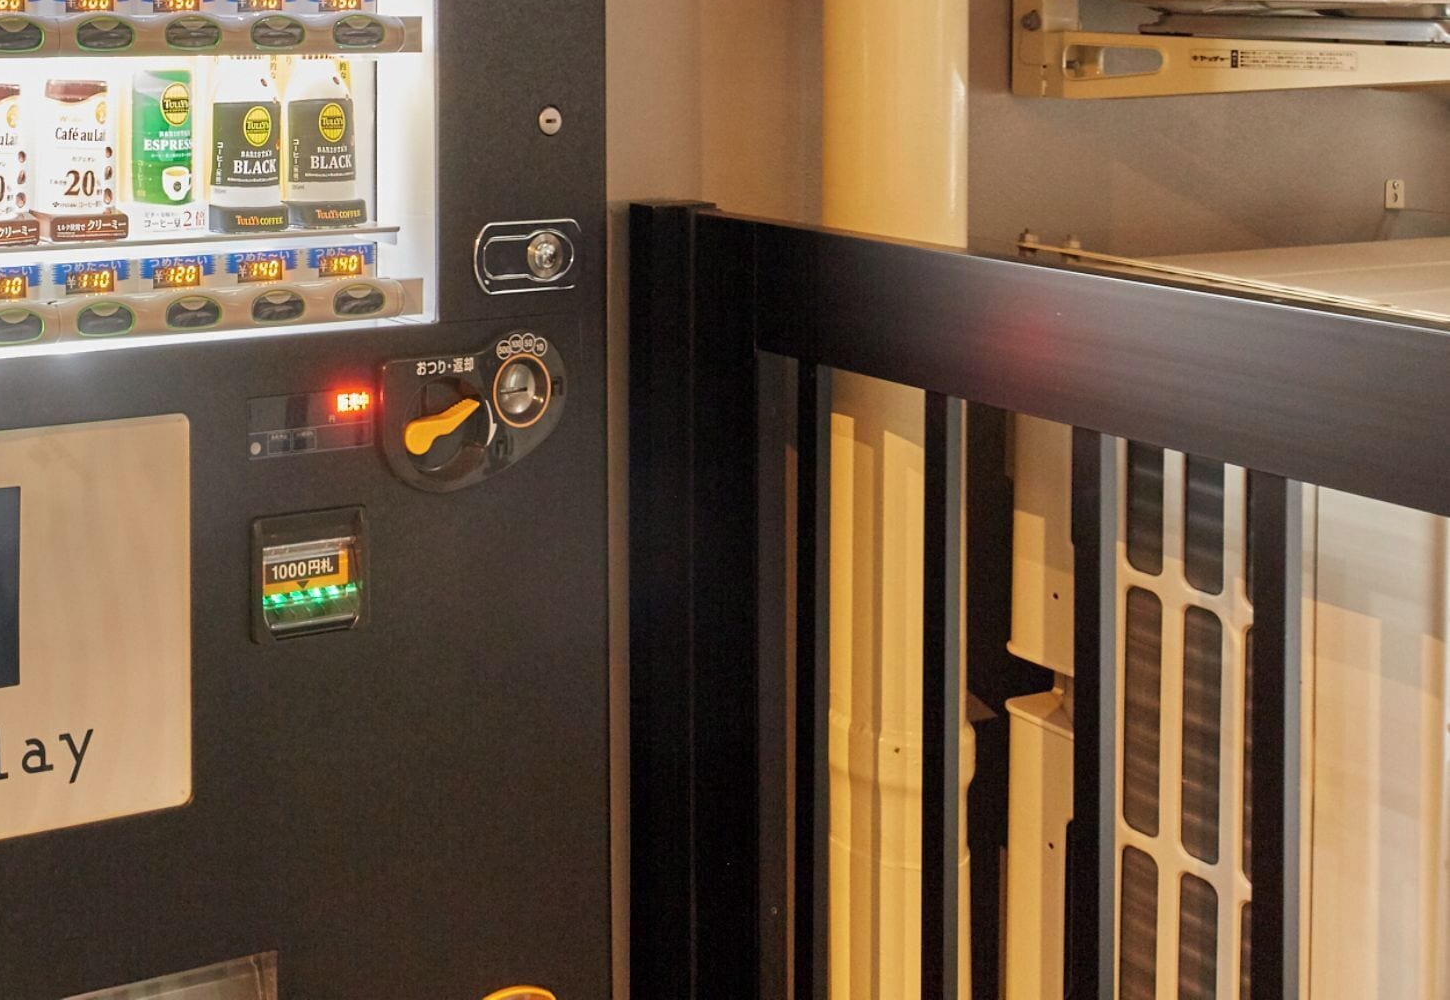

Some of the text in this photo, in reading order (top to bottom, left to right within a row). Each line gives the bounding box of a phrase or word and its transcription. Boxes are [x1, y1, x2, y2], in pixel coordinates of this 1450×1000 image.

[55, 127, 79, 141] Café
[80, 131, 93, 141] au
[233, 159, 277, 175] BLACK
[310, 154, 352, 170] BLACK
[64, 170, 95, 196] 20
[87, 219, 126, 231] クリーミー
[416, 357, 475, 376] おつり・返却
[271, 557, 334, 581] 1000円札
